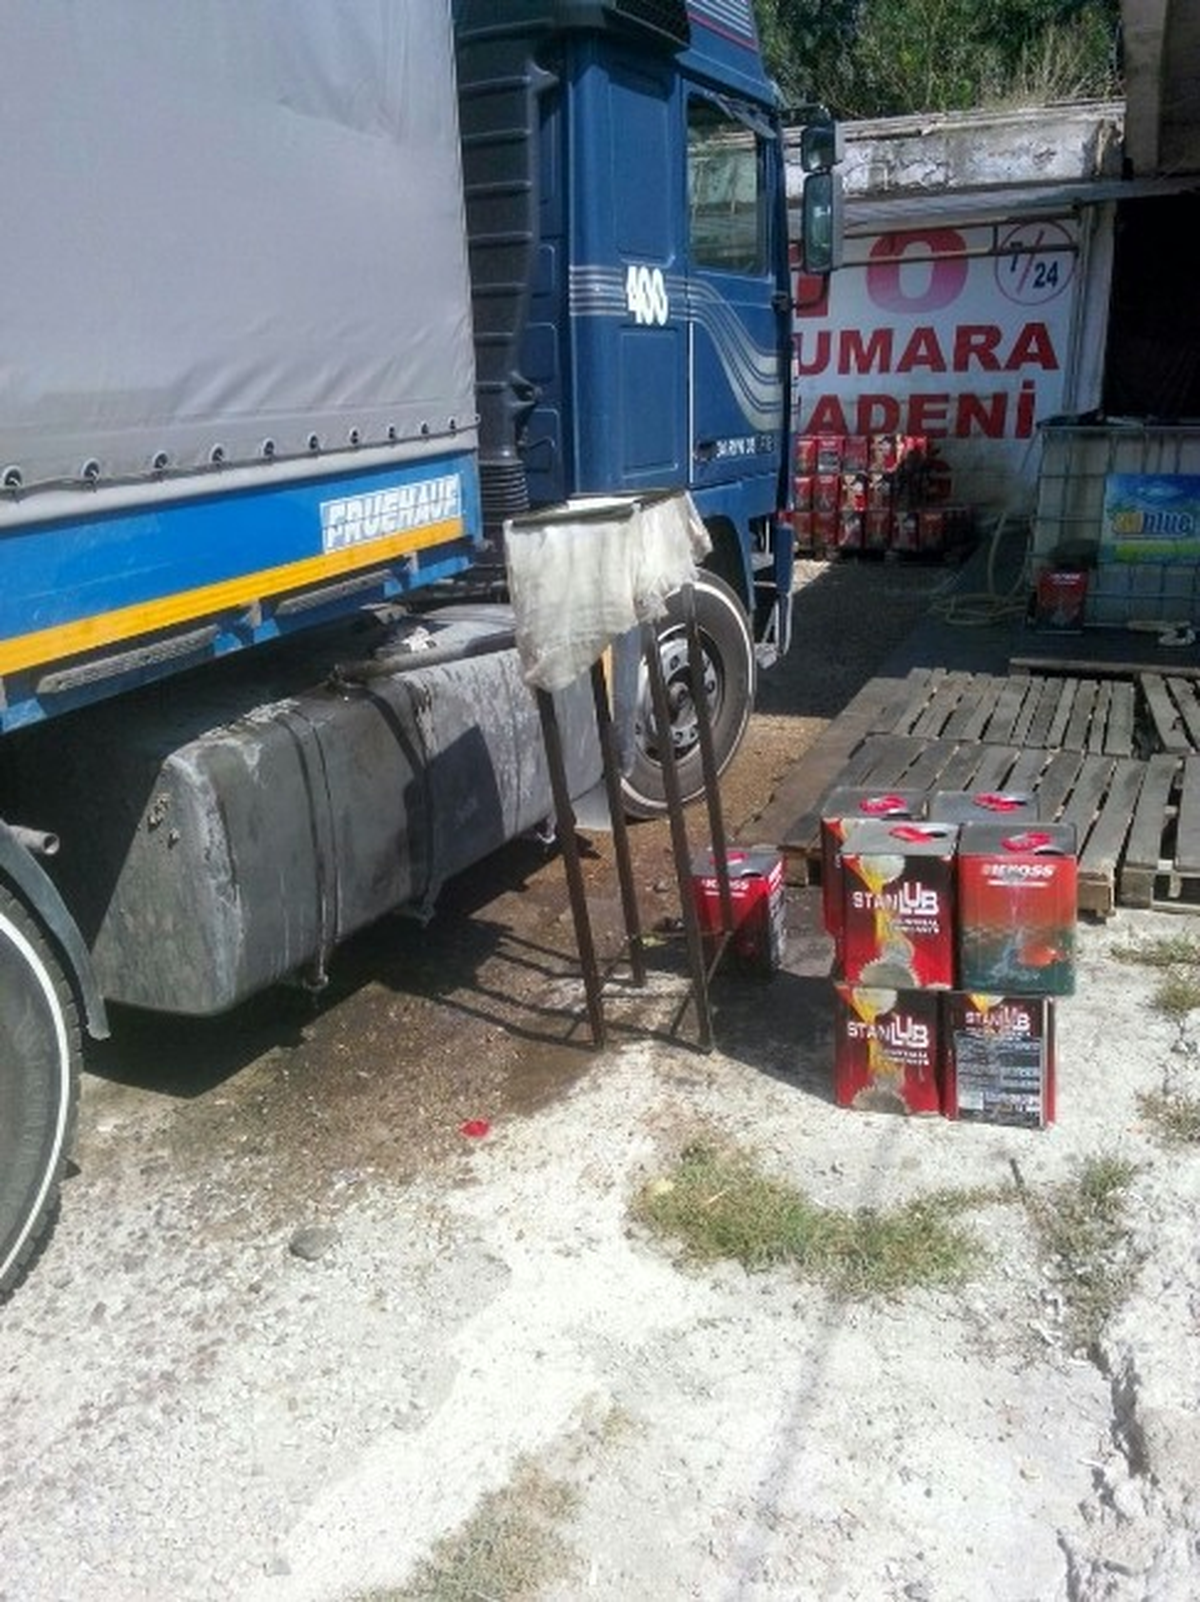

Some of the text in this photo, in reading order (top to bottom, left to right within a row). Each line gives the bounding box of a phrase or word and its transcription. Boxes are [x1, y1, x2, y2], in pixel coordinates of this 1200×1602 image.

[626, 266, 668, 326] 400
[325, 476, 459, 549] FRUEHAUF
[852, 881, 940, 916] STANLUB
[846, 1015, 929, 1049] STANLUB
